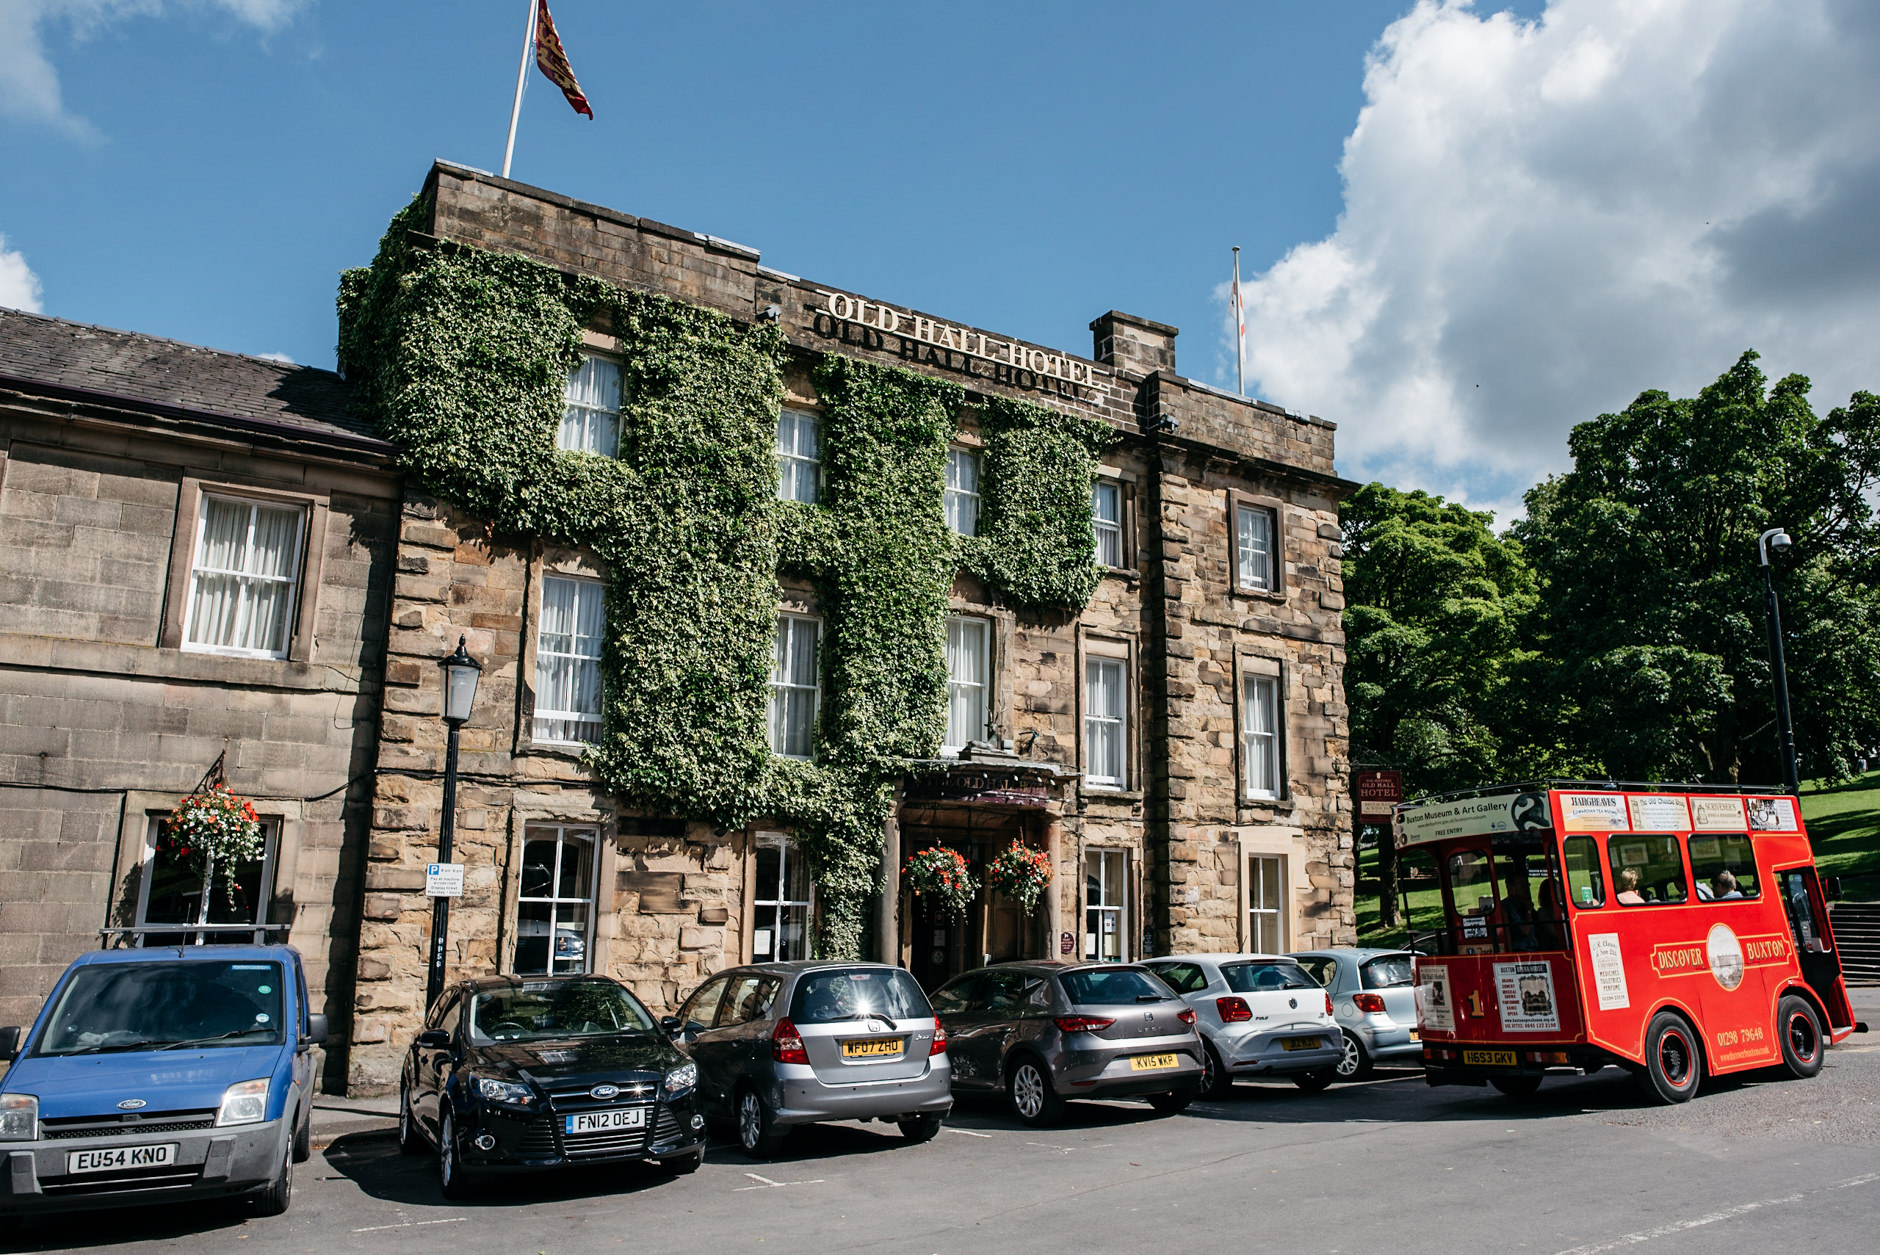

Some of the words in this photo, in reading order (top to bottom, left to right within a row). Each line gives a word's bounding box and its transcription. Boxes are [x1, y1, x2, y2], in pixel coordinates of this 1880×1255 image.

[828, 292, 900, 333] OLD
[915, 315, 996, 360] HALL
[1006, 341, 1103, 389] HOTEL
[958, 776, 984, 789] OLD
[1361, 789, 1398, 797] HOTEL
[1571, 797, 1617, 807] HARGREAVES
[1407, 814, 1423, 824] Buxton
[1424, 809, 1452, 820] Museum
[1454, 807, 1460, 815] &
[1462, 805, 1475, 813] Art
[1476, 802, 1508, 812] Gallery
[1435, 829, 1445, 837] FREE
[1447, 827, 1463, 835] ENTRY
[431, 866, 438, 875] P
[1657, 948, 1703, 970] DISCOVER
[1746, 940, 1786, 961] BUXTON
[1468, 990, 1484, 1017] 1
[1717, 1030, 1739, 1047] 01298
[1741, 1027, 1764, 1043] 79648
[848, 1041, 875, 1054] WF07
[878, 1039, 898, 1052] ZHO
[1136, 1057, 1156, 1068] KV15
[1467, 1052, 1492, 1063] H653
[578, 1114, 609, 1130] FN12
[613, 1110, 640, 1126] OEJ
[78, 1150, 126, 1169] EU54
[131, 1147, 167, 1165] KNO
